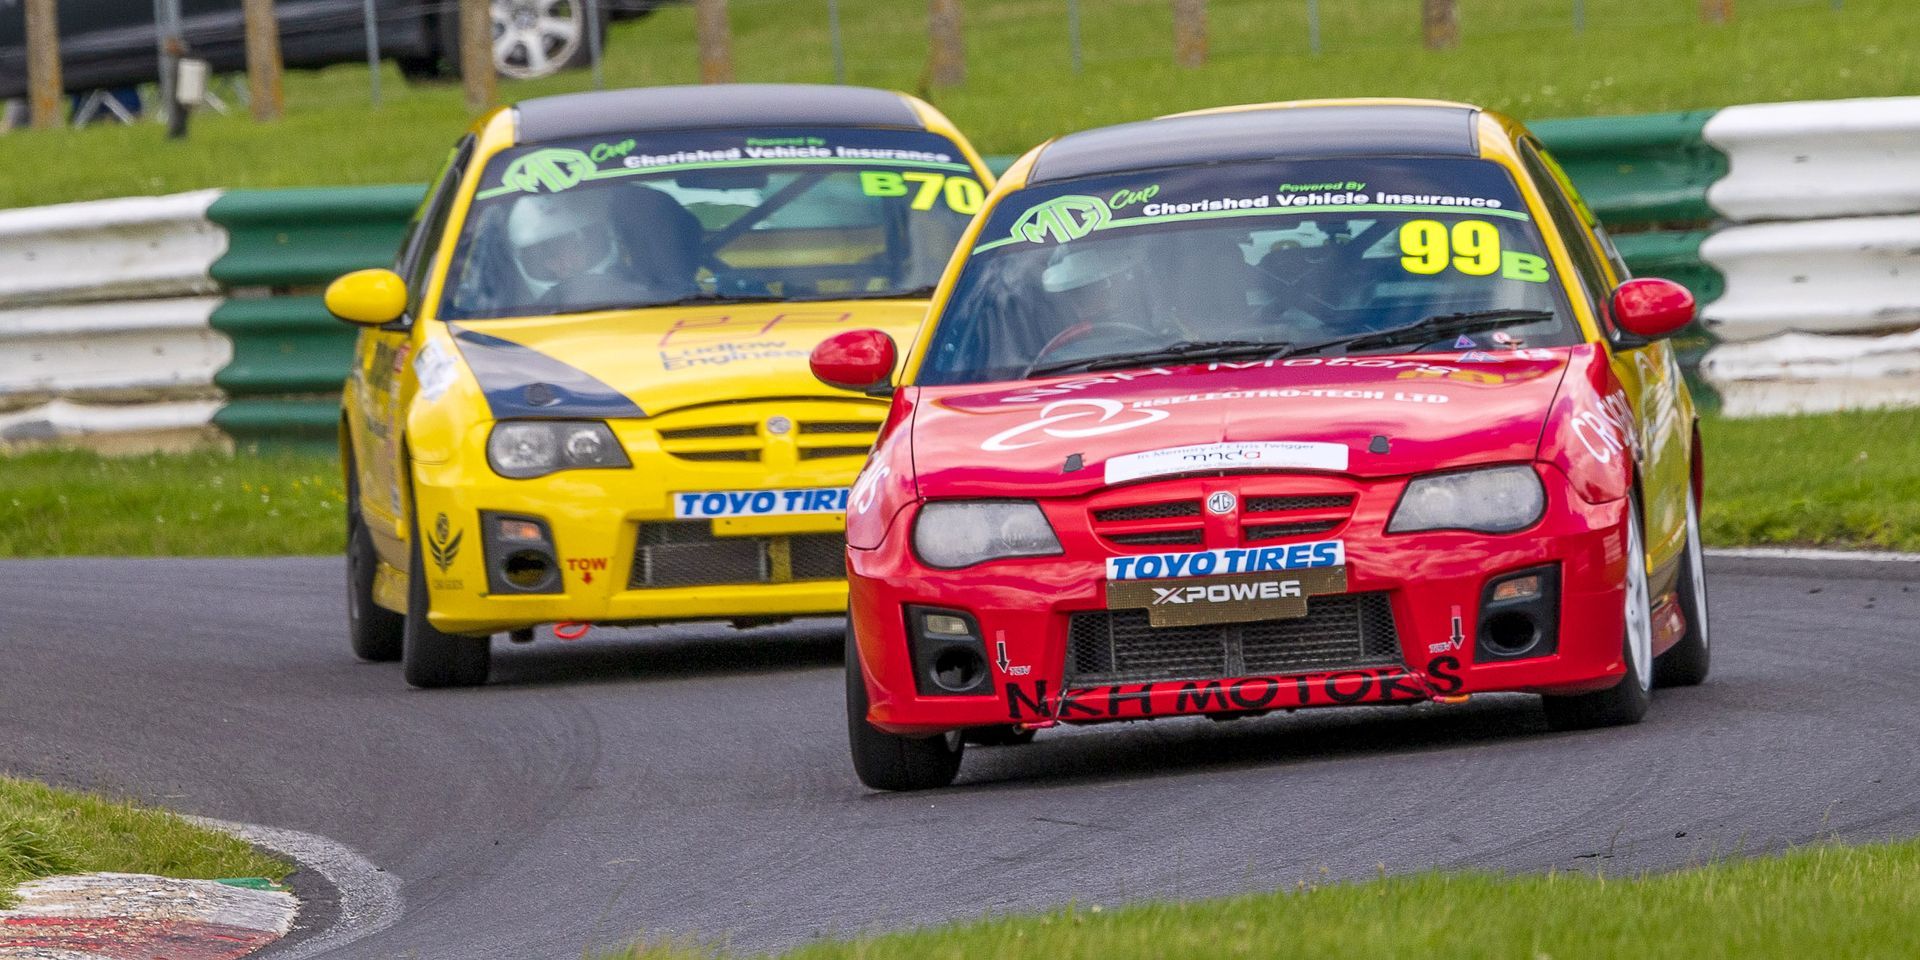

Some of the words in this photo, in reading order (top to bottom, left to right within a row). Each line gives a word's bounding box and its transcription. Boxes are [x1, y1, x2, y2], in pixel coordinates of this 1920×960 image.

[623, 146, 741, 169] Cherished
[745, 144, 832, 160] Vehicle
[835, 146, 951, 163] Insurance
[1109, 184, 1160, 209] Cup
[1279, 181, 1343, 193] Powered
[1344, 180, 1367, 192] By
[1142, 194, 1269, 217] Cherished
[1276, 191, 1370, 207] Vehicle
[1376, 191, 1502, 209] Insurance
[1012, 195, 1110, 244] MG
[1399, 218, 1501, 277] 99
[659, 340, 787, 363] Ludlow
[1207, 356, 1461, 376] Motors
[1394, 390, 1450, 405] LTD
[681, 491, 776, 515] TOYO
[1208, 491, 1237, 514] MG
[566, 558, 608, 571] TOW
[1113, 551, 1218, 580] TOYO
[1223, 542, 1338, 574] TIRES
[1151, 579, 1301, 606] XPOWER
